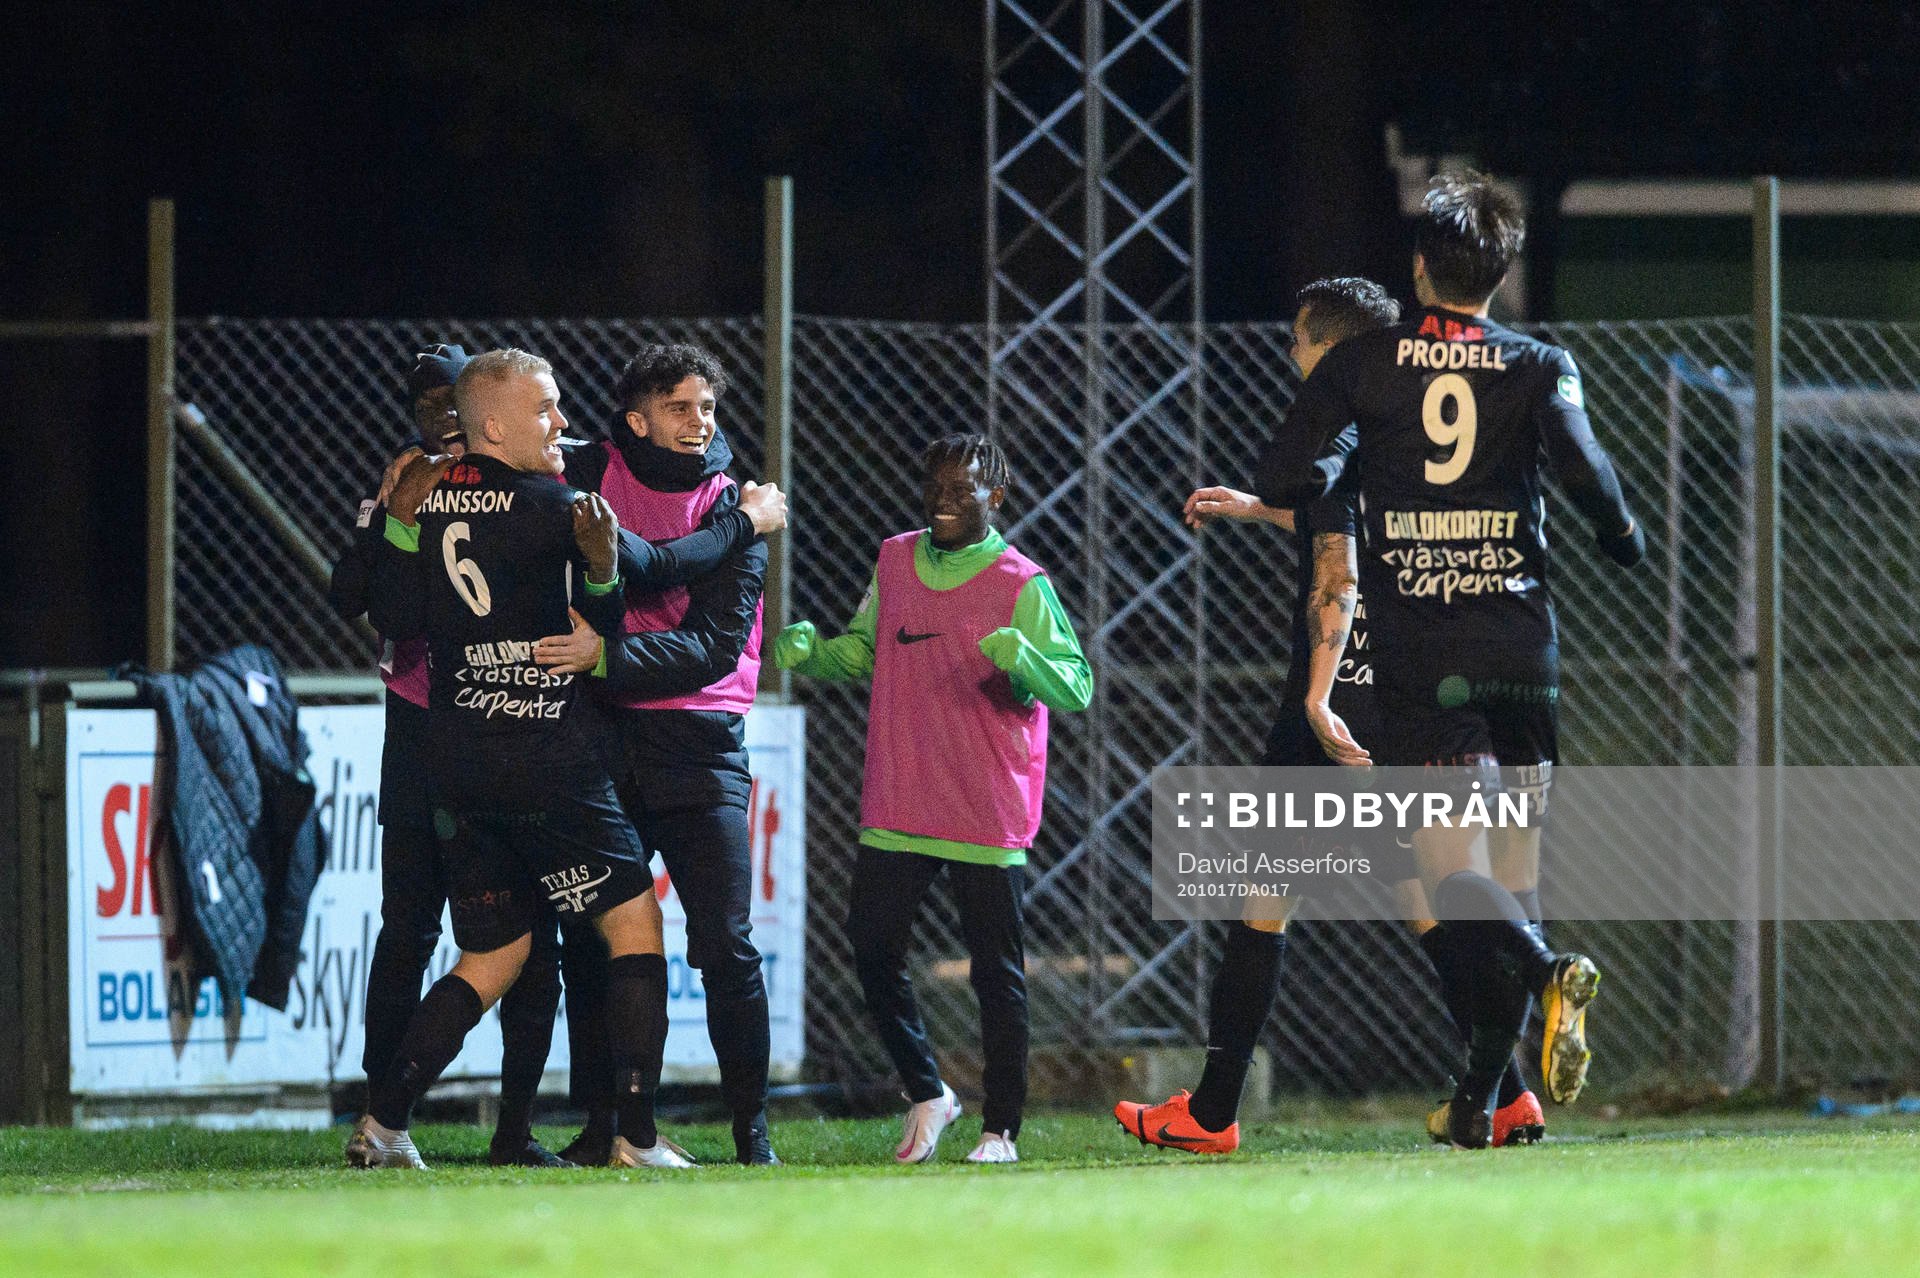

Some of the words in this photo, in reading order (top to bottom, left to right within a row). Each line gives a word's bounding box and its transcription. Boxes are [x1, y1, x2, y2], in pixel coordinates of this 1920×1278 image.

[1396, 338, 1507, 371] PRODELL
[1422, 373, 1478, 485] 9
[414, 489, 515, 515] HANSSON
[1384, 509, 1519, 541] GULDKORTET
[442, 521, 491, 617] 6
[540, 864, 590, 892] TEXAS
